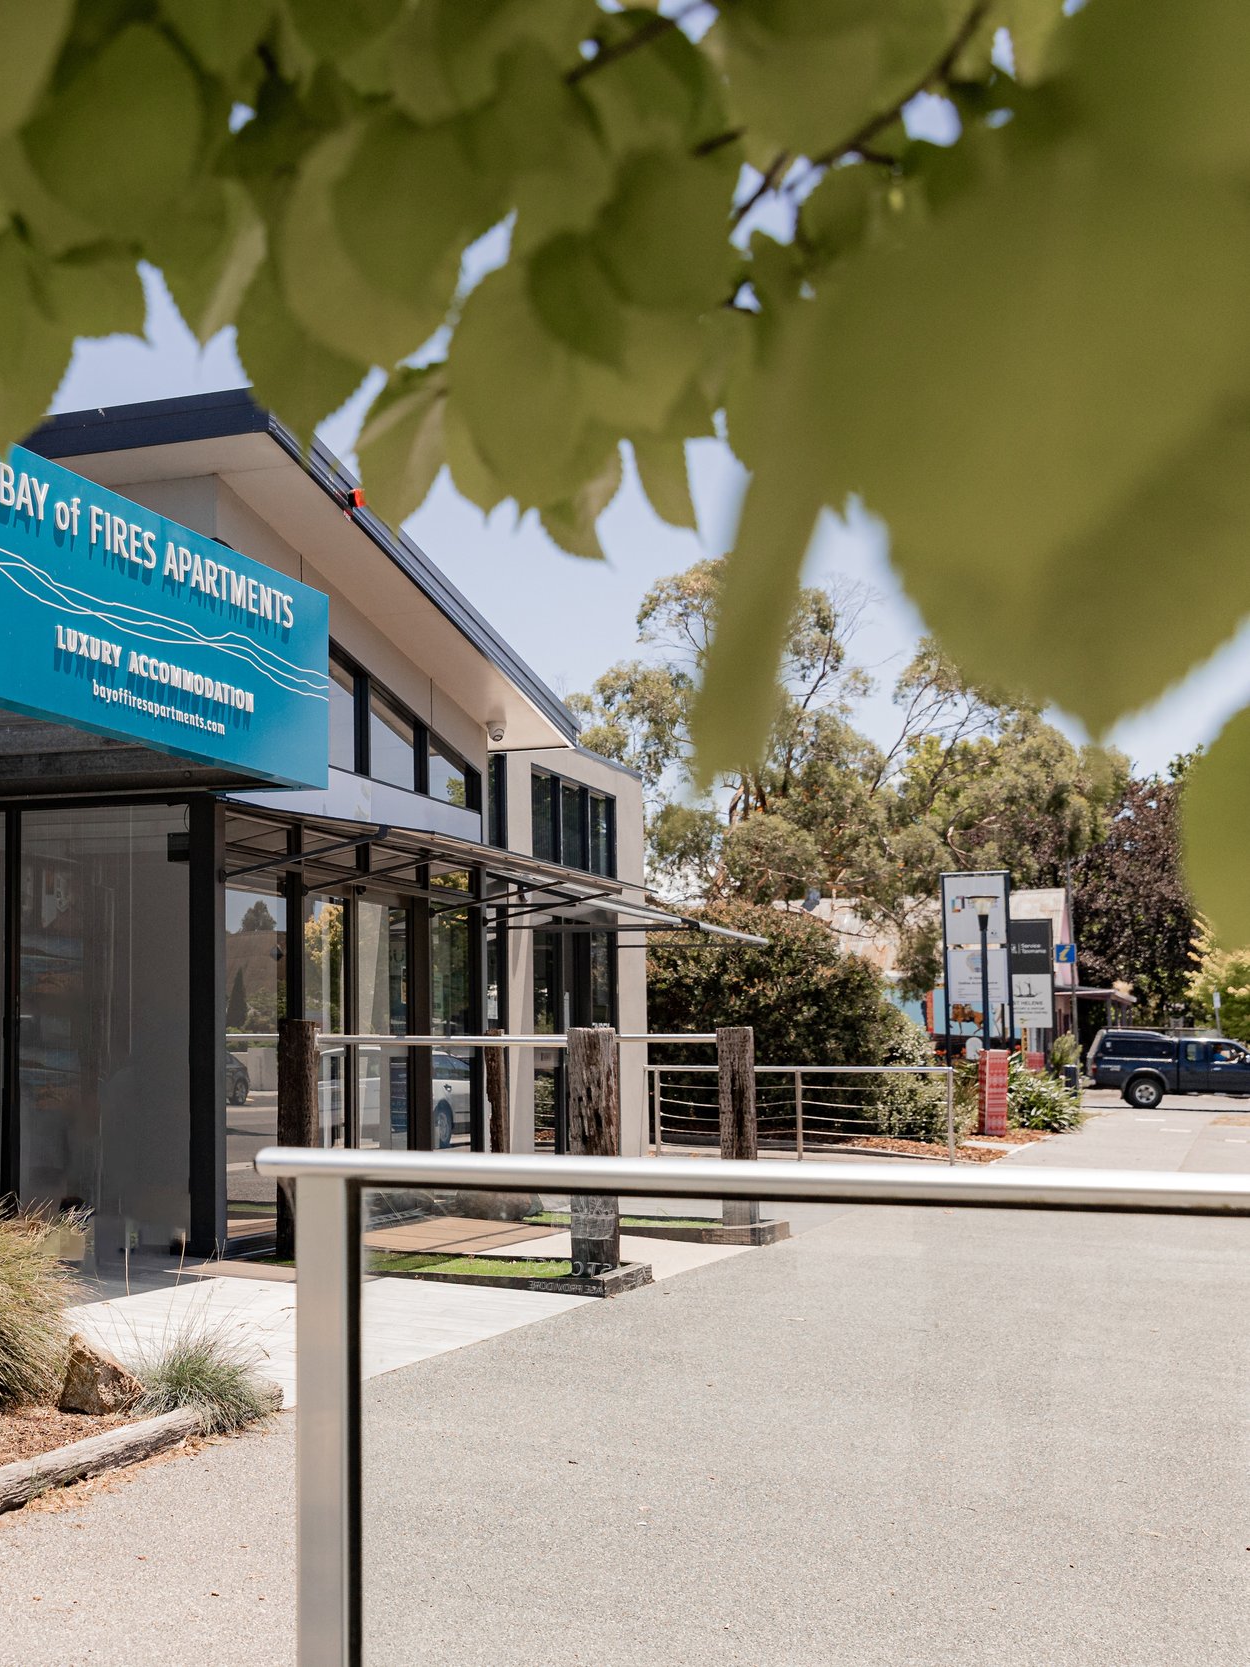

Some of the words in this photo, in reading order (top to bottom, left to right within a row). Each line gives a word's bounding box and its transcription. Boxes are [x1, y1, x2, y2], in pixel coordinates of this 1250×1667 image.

[54, 498, 81, 536] of
[89, 505, 156, 569] FIRES
[163, 541, 294, 629] APARTMENTS
[55, 624, 122, 668] LUXURY
[128, 651, 254, 713] ACCOMMODATION
[92, 679, 225, 735] bayoffiresapartments.com
